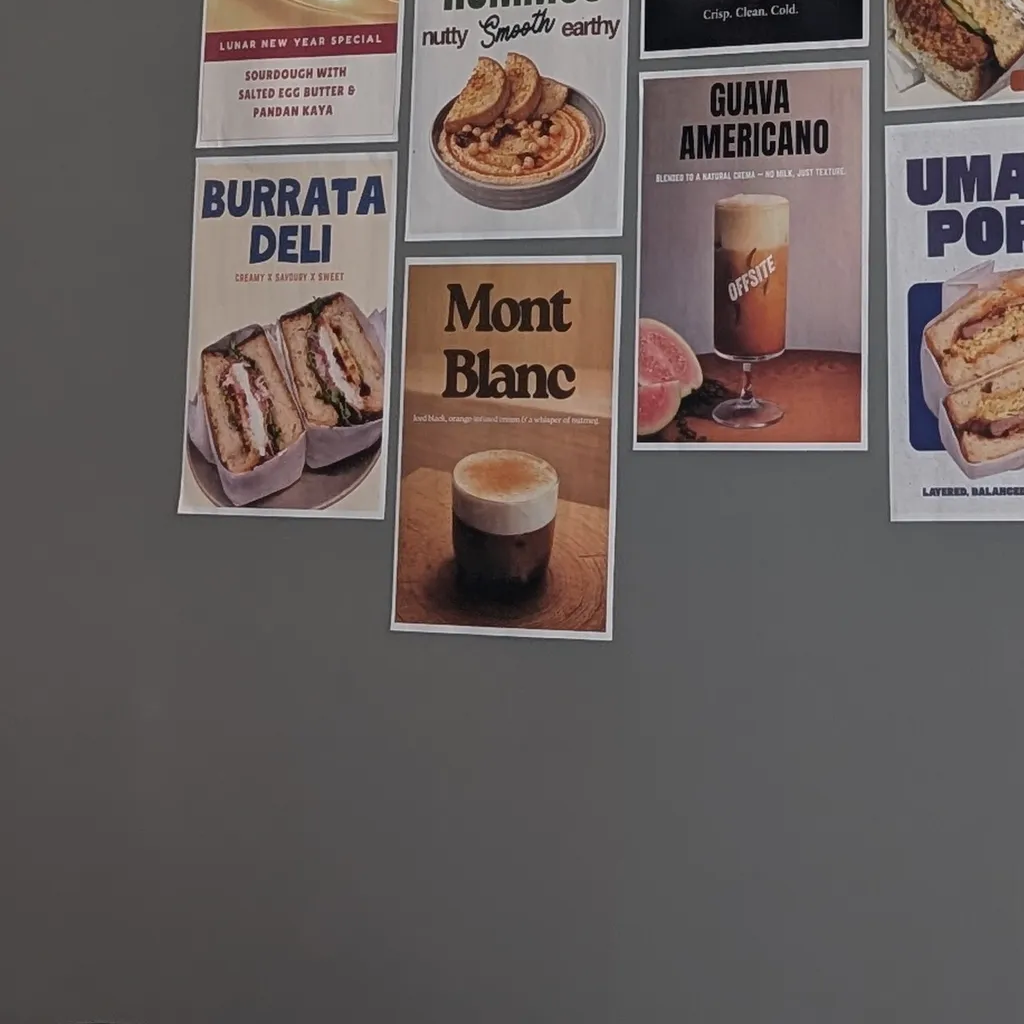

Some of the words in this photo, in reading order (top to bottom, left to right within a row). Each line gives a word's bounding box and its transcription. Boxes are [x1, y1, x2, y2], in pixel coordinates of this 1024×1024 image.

[703, 8, 732, 22] Crisp.
[736, 6, 768, 17] Clean.
[771, 3, 799, 15] Cold.
[219, 40, 256, 51] LUNAR
[261, 38, 287, 48] NEW
[294, 37, 325, 47] YEAR
[331, 34, 382, 45] SPECIAL
[422, 27, 469, 49] nutty
[479, 8, 556, 48] Smooth
[561, 16, 620, 40] earthy
[245, 67, 313, 81] SOURDOUGH
[317, 66, 347, 78] WITH
[238, 88, 275, 100] SALTED
[278, 86, 300, 99] EGG
[304, 85, 344, 97] BUTTER
[348, 84, 355, 96] &
[710, 79, 790, 117] GUAVA
[253, 106, 298, 118] PANDAN
[302, 104, 333, 116] KAYA
[679, 119, 829, 160] AMERICANO
[656, 173, 684, 183] BLENDED
[685, 174, 694, 182] TO
[695, 173, 701, 181] A
[702, 172, 731, 181] NATURAL
[765, 170, 774, 178] NO
[797, 168, 814, 178] JUST
[202, 175, 386, 219] BURRATA
[249, 225, 331, 264] DELI
[235, 273, 265, 282] CREAMY
[275, 272, 307, 282] SAVOURY
[318, 272, 345, 281] SWEET
[728, 254, 776, 301] OFFSITE
[444, 283, 573, 333] Mont
[441, 348, 576, 400] Blanc
[922, 487, 969, 497] LAYERED,
